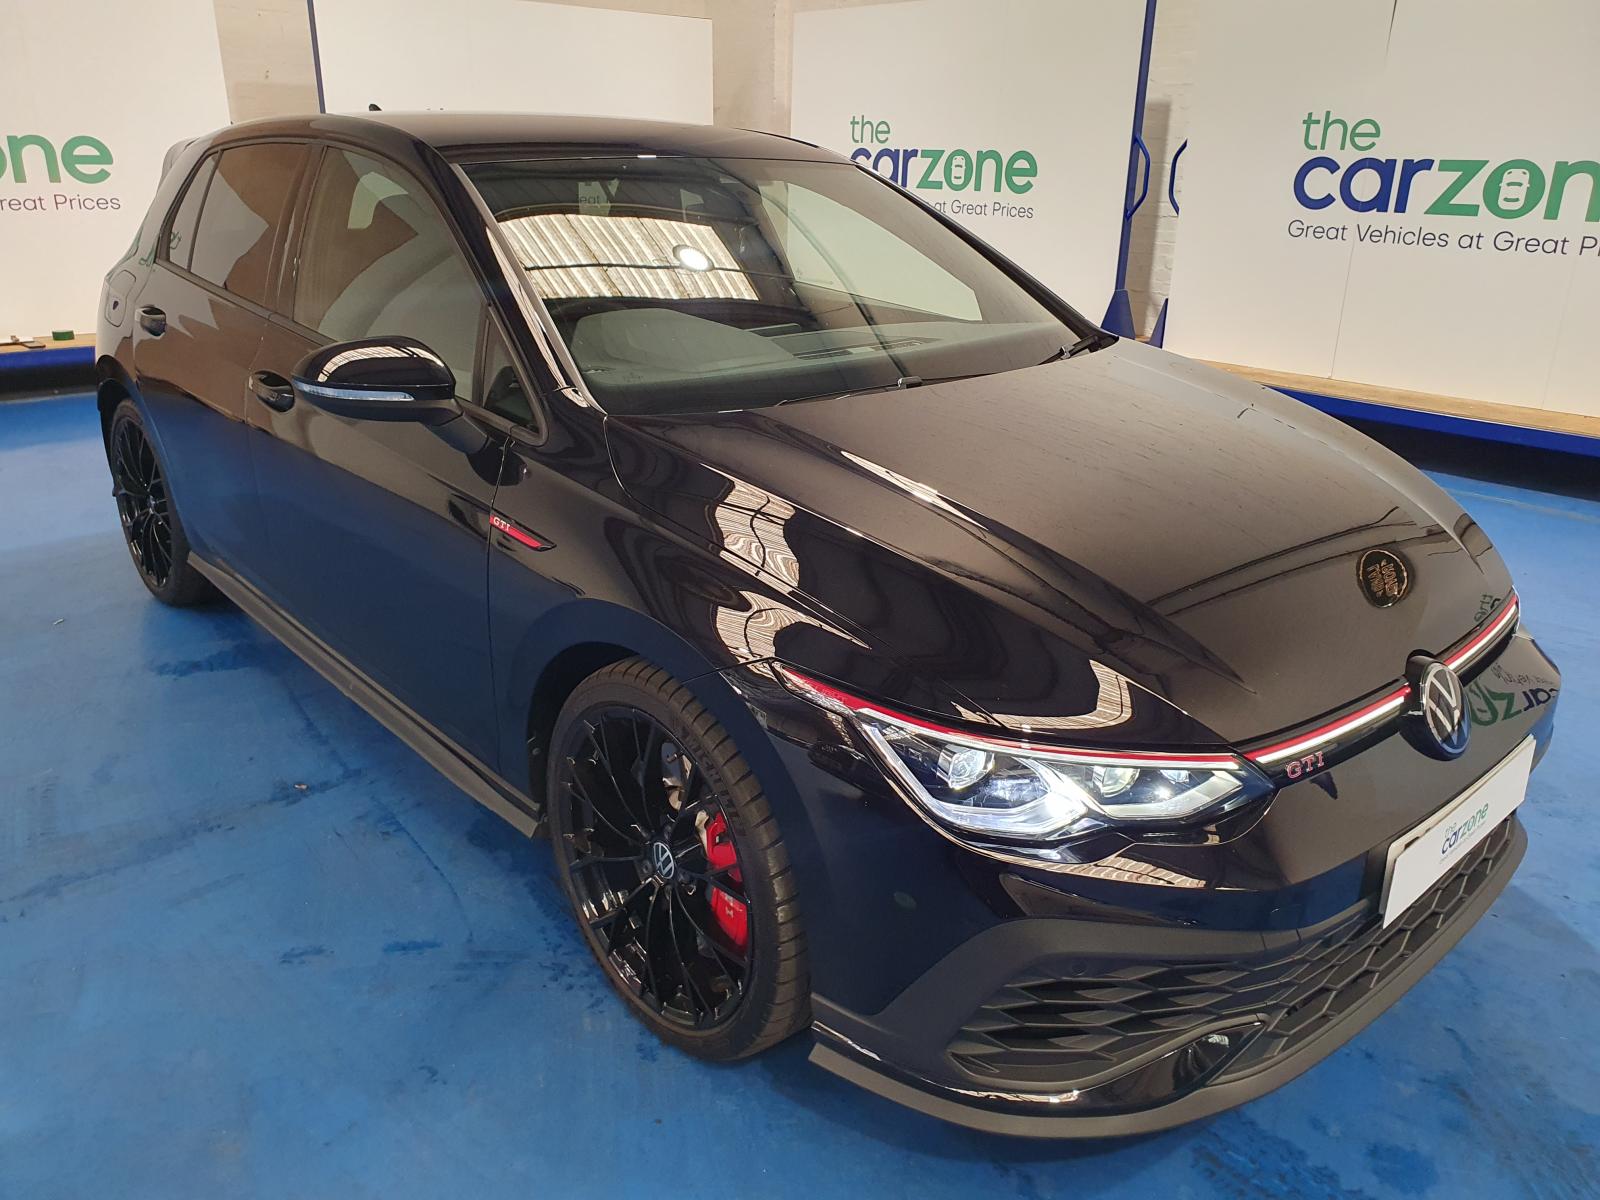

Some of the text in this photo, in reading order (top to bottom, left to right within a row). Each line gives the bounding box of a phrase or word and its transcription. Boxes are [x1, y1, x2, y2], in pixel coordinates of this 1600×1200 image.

[850, 114, 891, 144] the
[1302, 110, 1381, 152] the
[0, 134, 114, 185] ne
[53, 194, 121, 211] Prices
[951, 199, 988, 216] Great
[992, 201, 1034, 219] Prices
[1287, 219, 1600, 257] Great Vehicles at Great P
[493, 516, 511, 532] GTI
[1286, 751, 1324, 779] GTI
[1441, 803, 1489, 855] carzone
